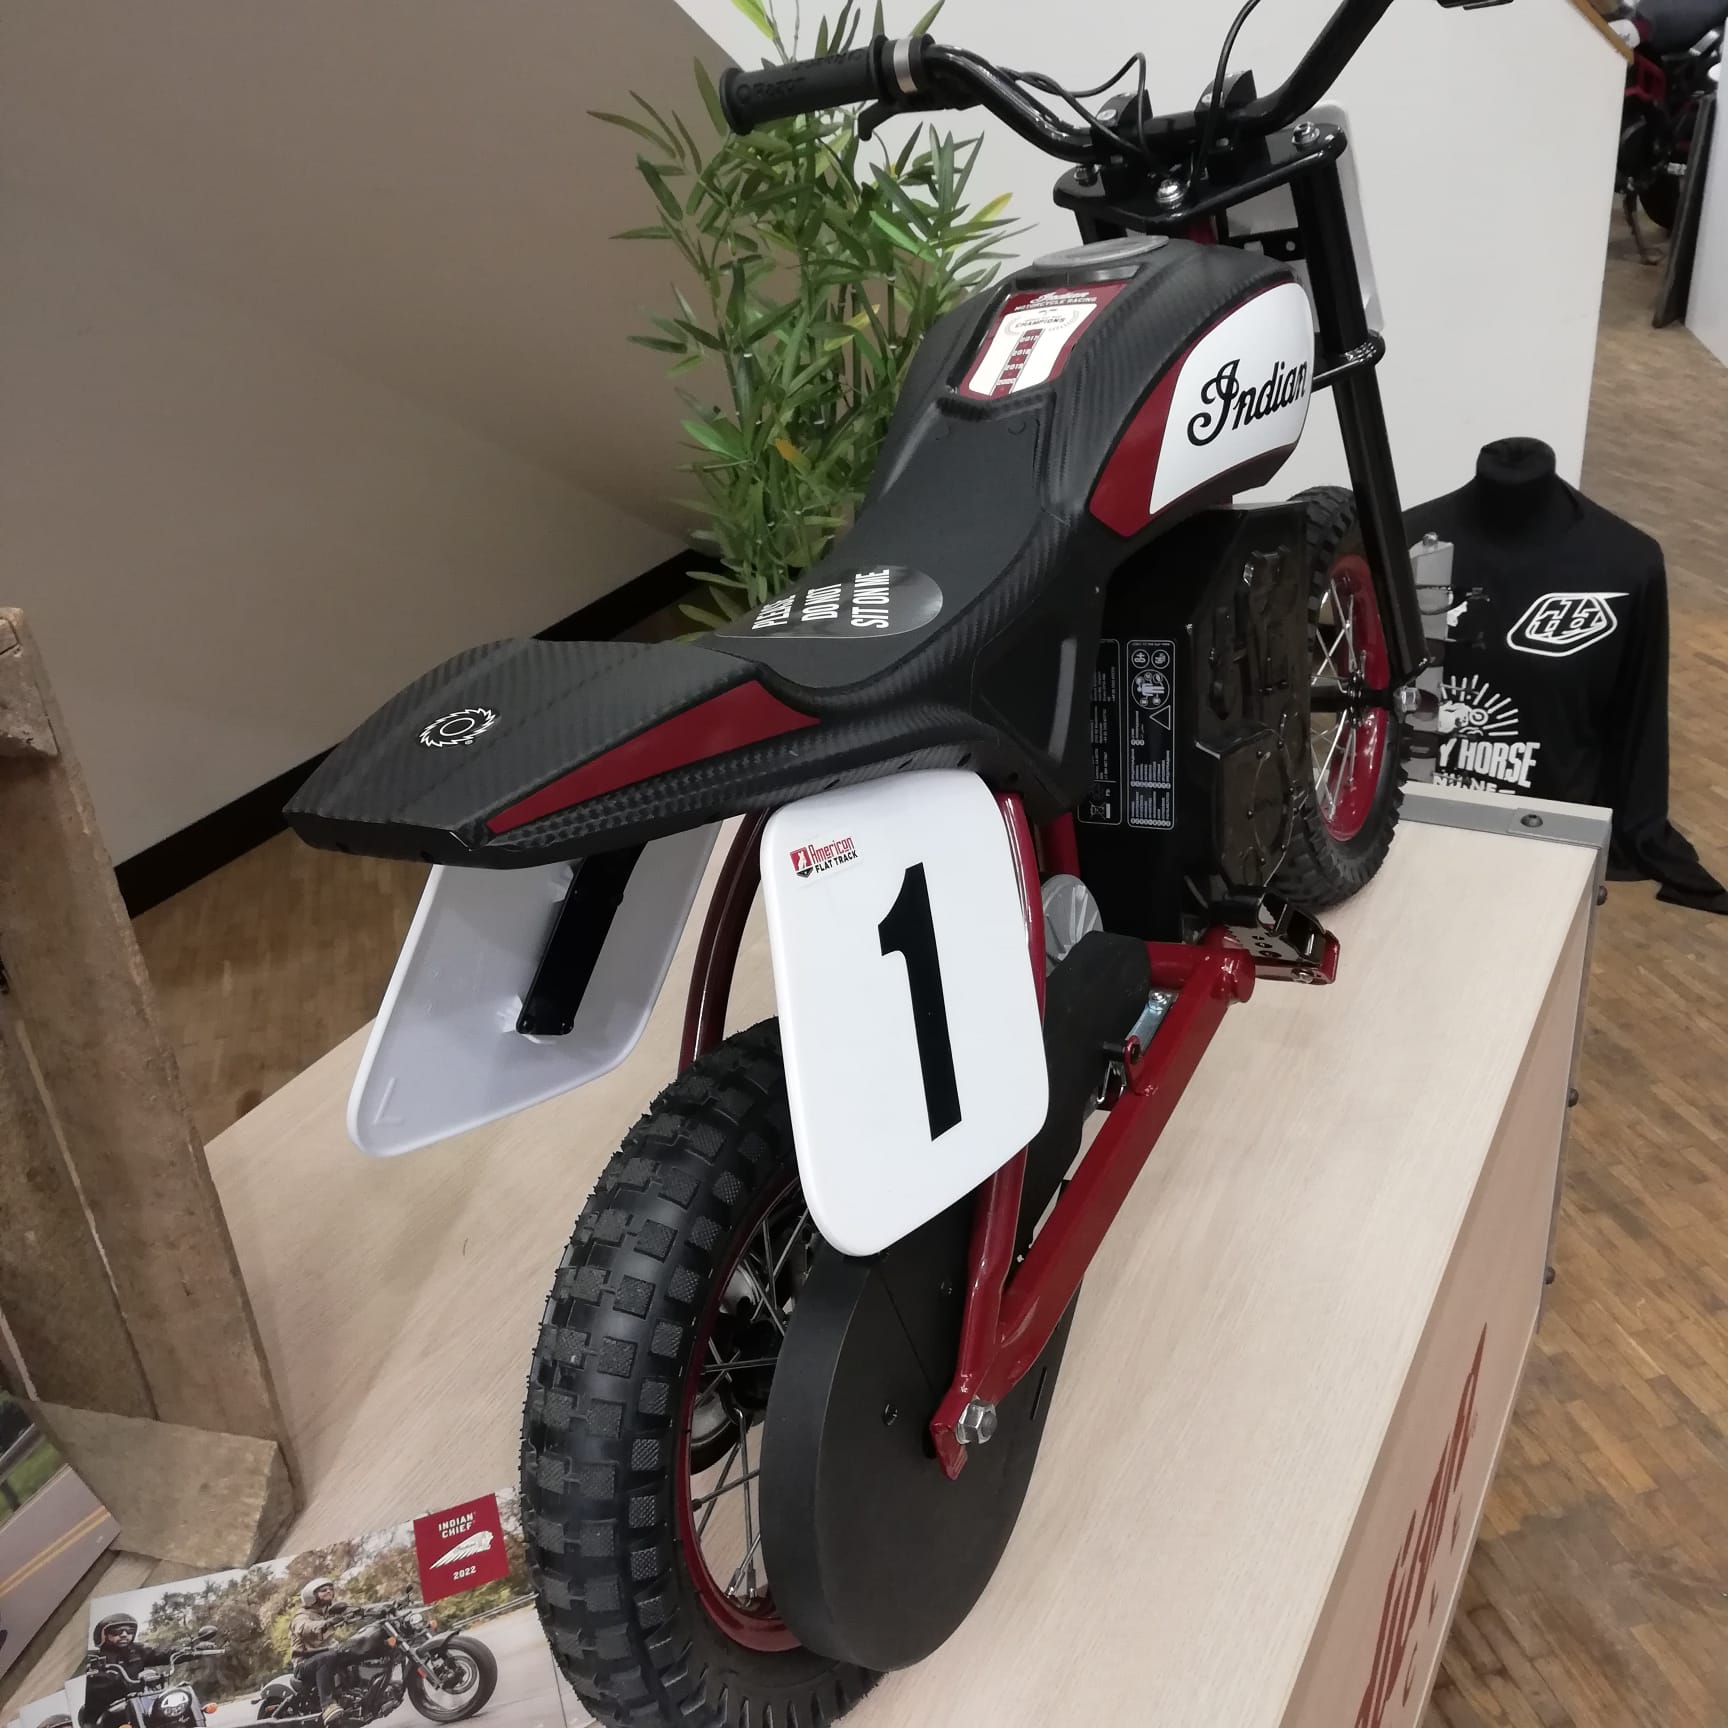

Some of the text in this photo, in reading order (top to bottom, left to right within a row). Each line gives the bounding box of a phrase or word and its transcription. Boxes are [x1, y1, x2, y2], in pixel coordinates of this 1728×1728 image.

[1014, 317, 1066, 329] CHAMPIONS
[1187, 359, 1308, 447] Indian
[801, 583, 842, 622] DO NOT
[850, 569, 890, 629] SIT ON ME
[1457, 738, 1541, 788] HORSE
[808, 837, 855, 865] American
[815, 850, 858, 874] FLAT TRACK
[878, 861, 962, 1142] 1
[438, 1512, 474, 1531] INDIAN
[441, 1521, 473, 1539] CHIEF
[453, 1565, 477, 1580] 2022
